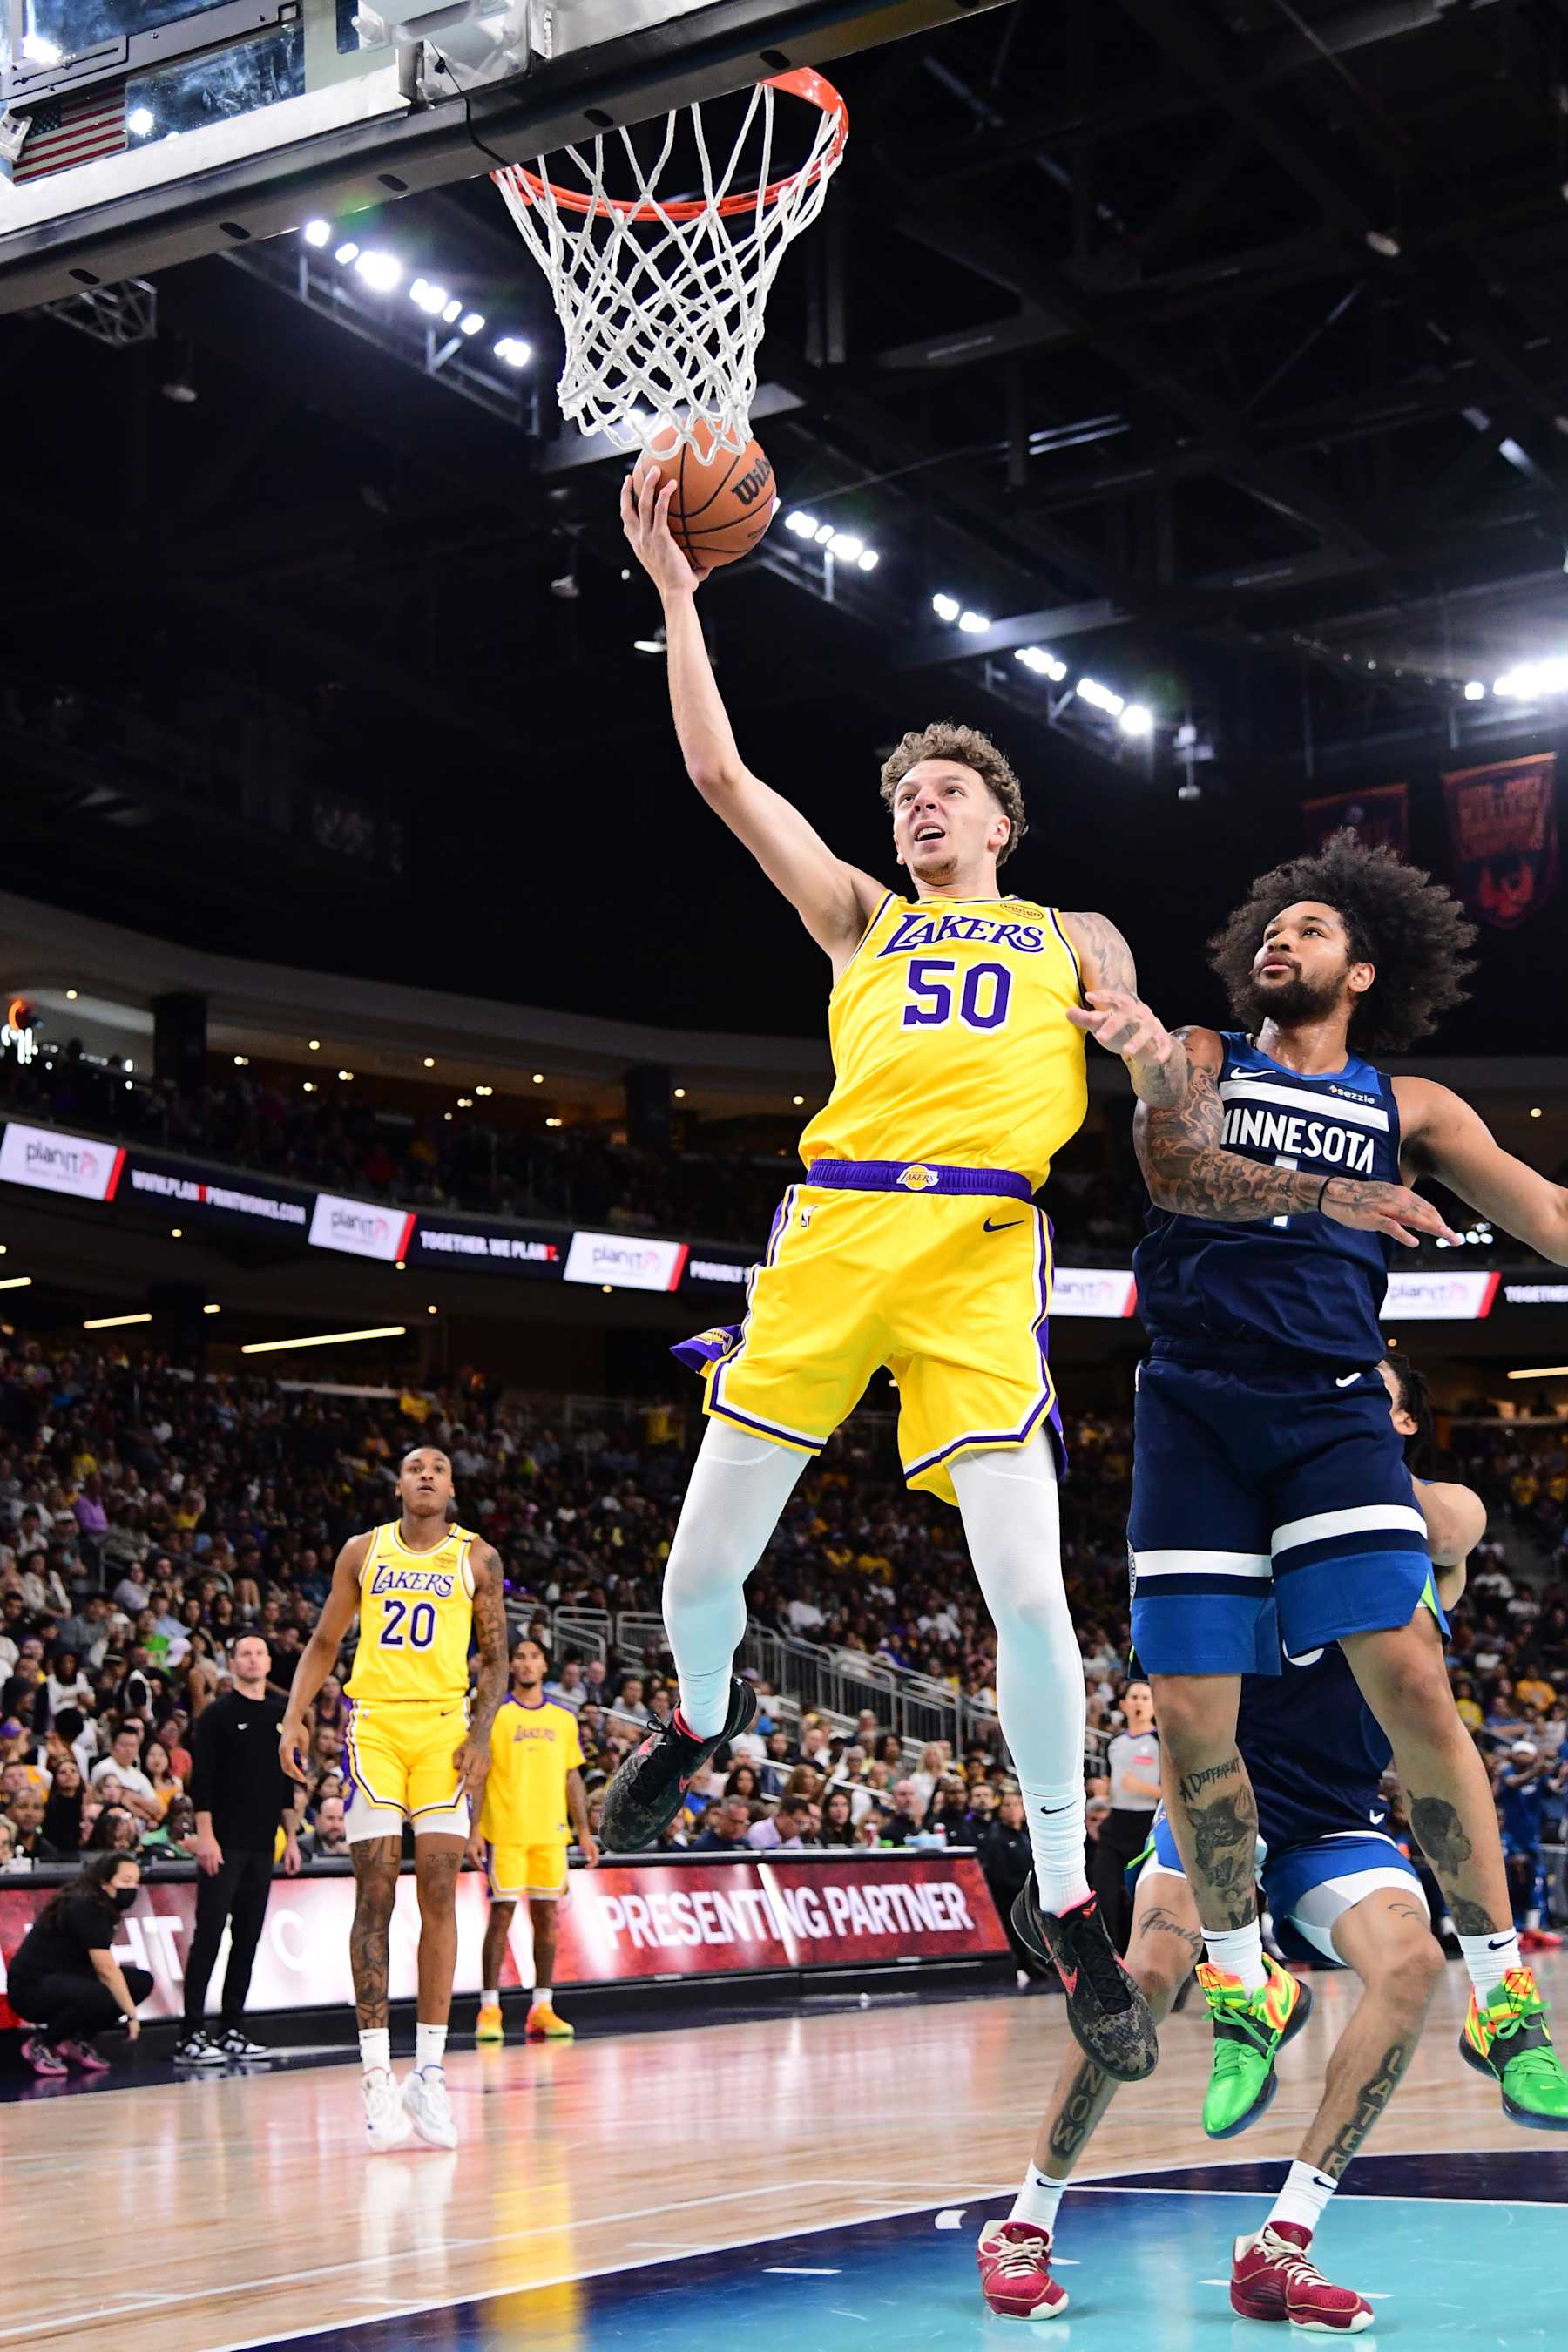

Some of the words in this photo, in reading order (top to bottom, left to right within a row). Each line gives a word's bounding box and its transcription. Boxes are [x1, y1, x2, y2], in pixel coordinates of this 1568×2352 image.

[875, 913, 1045, 958] LAKERS
[902, 959, 1012, 1031] 50
[1337, 1088, 1375, 1105] sezzle
[900, 1171, 935, 1186] LAKERS
[370, 1565, 455, 1598] LAKERS
[380, 1599, 436, 1648] 20
[513, 1725, 554, 1742] LAKERS
[596, 1887, 830, 1950] PRESENTING
[823, 1882, 975, 1937] PARTNER
[1052, 2060, 1105, 2153] NOW
[1322, 2047, 1402, 2180] LATER
